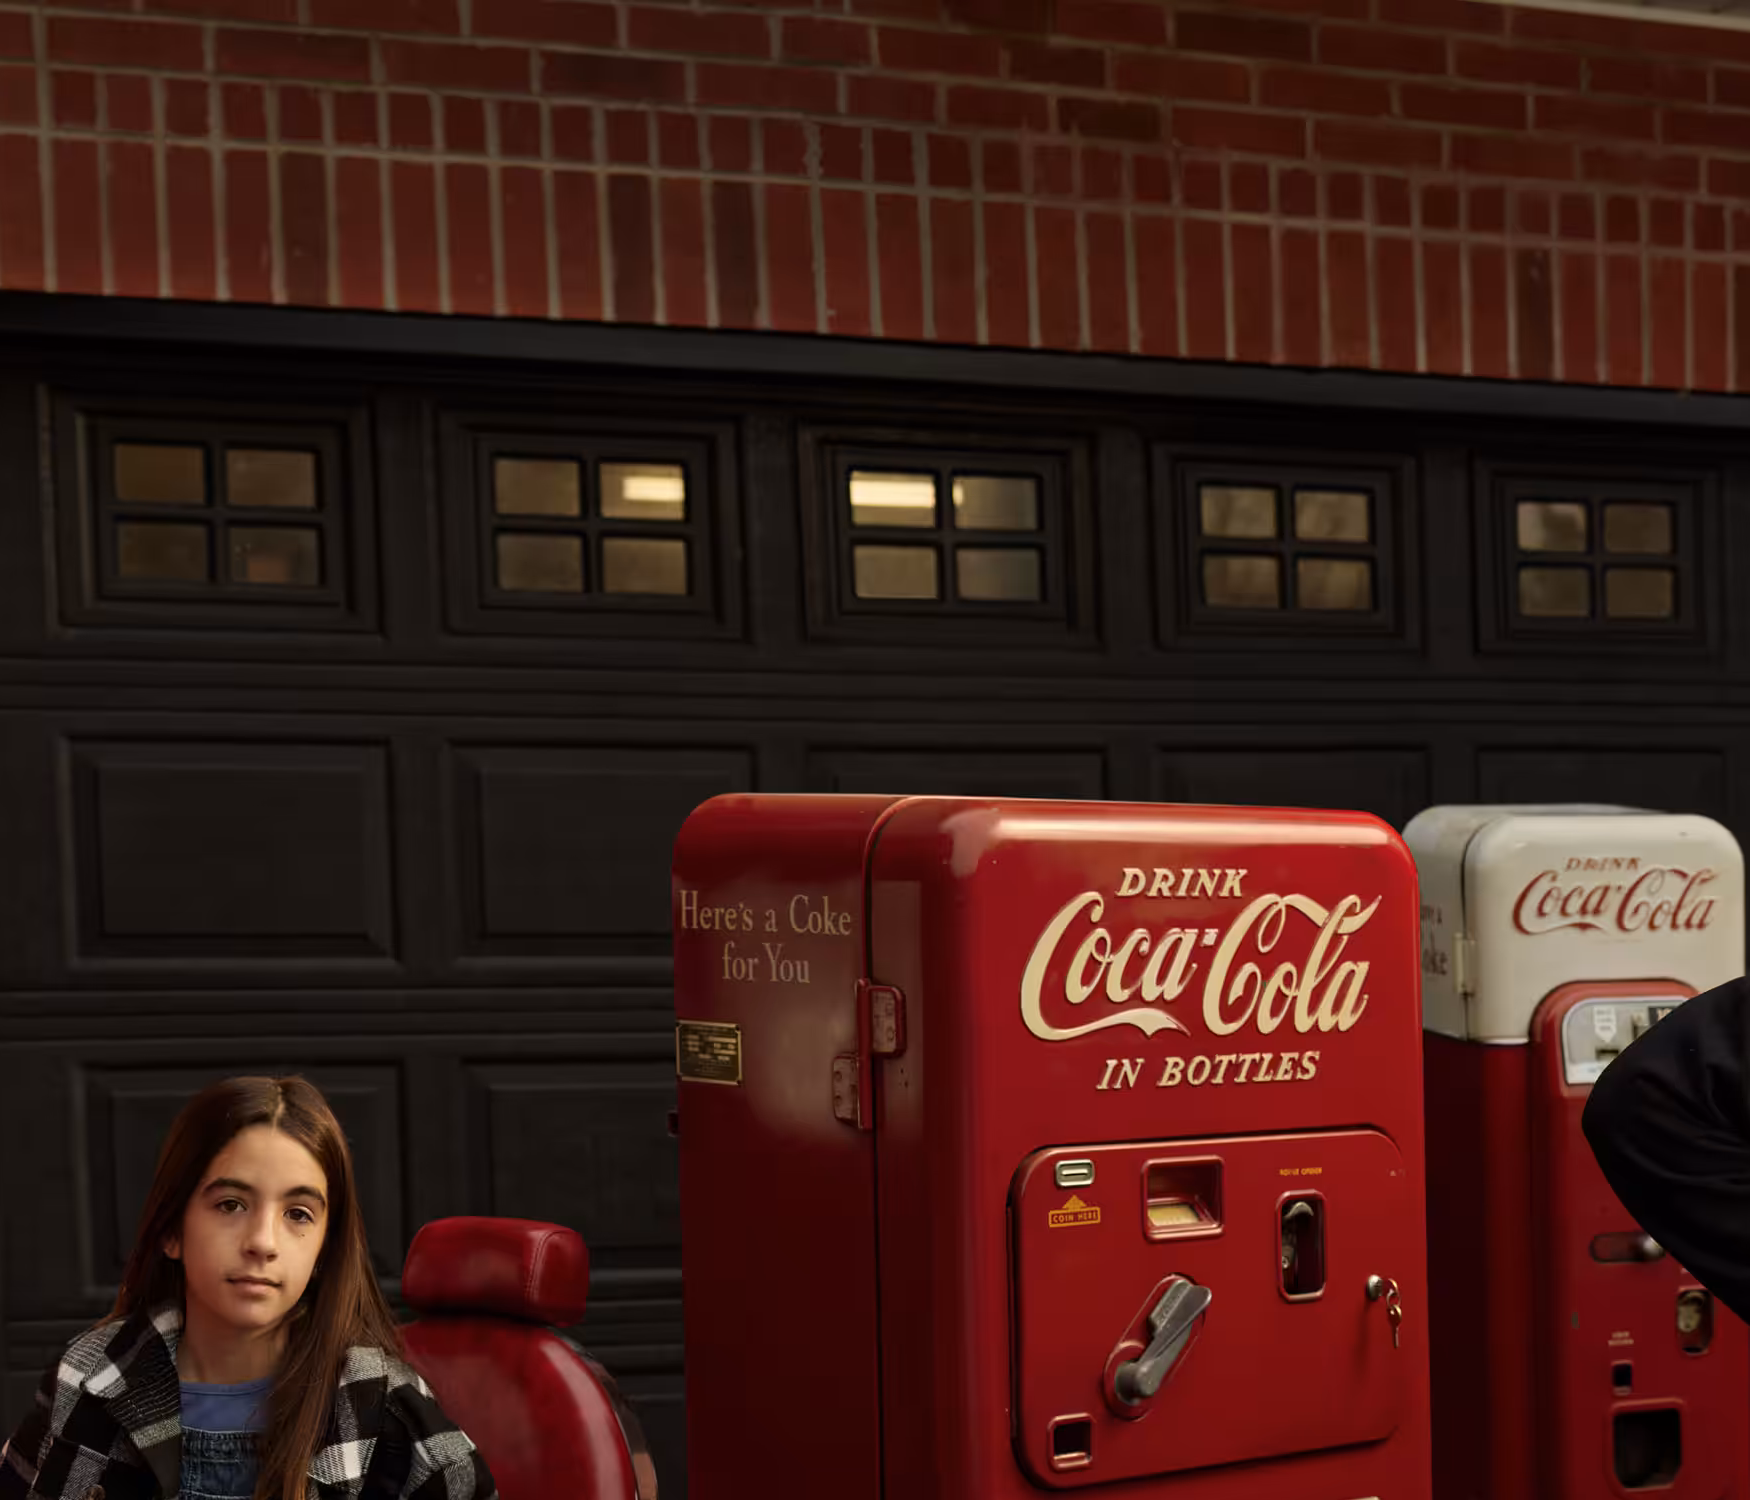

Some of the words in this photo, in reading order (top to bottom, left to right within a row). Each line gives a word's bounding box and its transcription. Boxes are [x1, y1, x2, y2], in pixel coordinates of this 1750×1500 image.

[1115, 867, 1247, 897] DRINK
[1565, 857, 1641, 872] DRINK
[680, 890, 753, 931] Here's
[765, 909, 778, 932] a
[790, 894, 851, 935] Coke
[1513, 867, 1718, 935] Coca-Cola
[722, 940, 759, 981] for
[762, 943, 810, 983] You
[1020, 891, 1382, 1041] Coca-Cola
[1096, 1058, 1144, 1089] IN
[1157, 1051, 1320, 1087] BOTTLES
[1053, 1214, 1074, 1223] COIN
